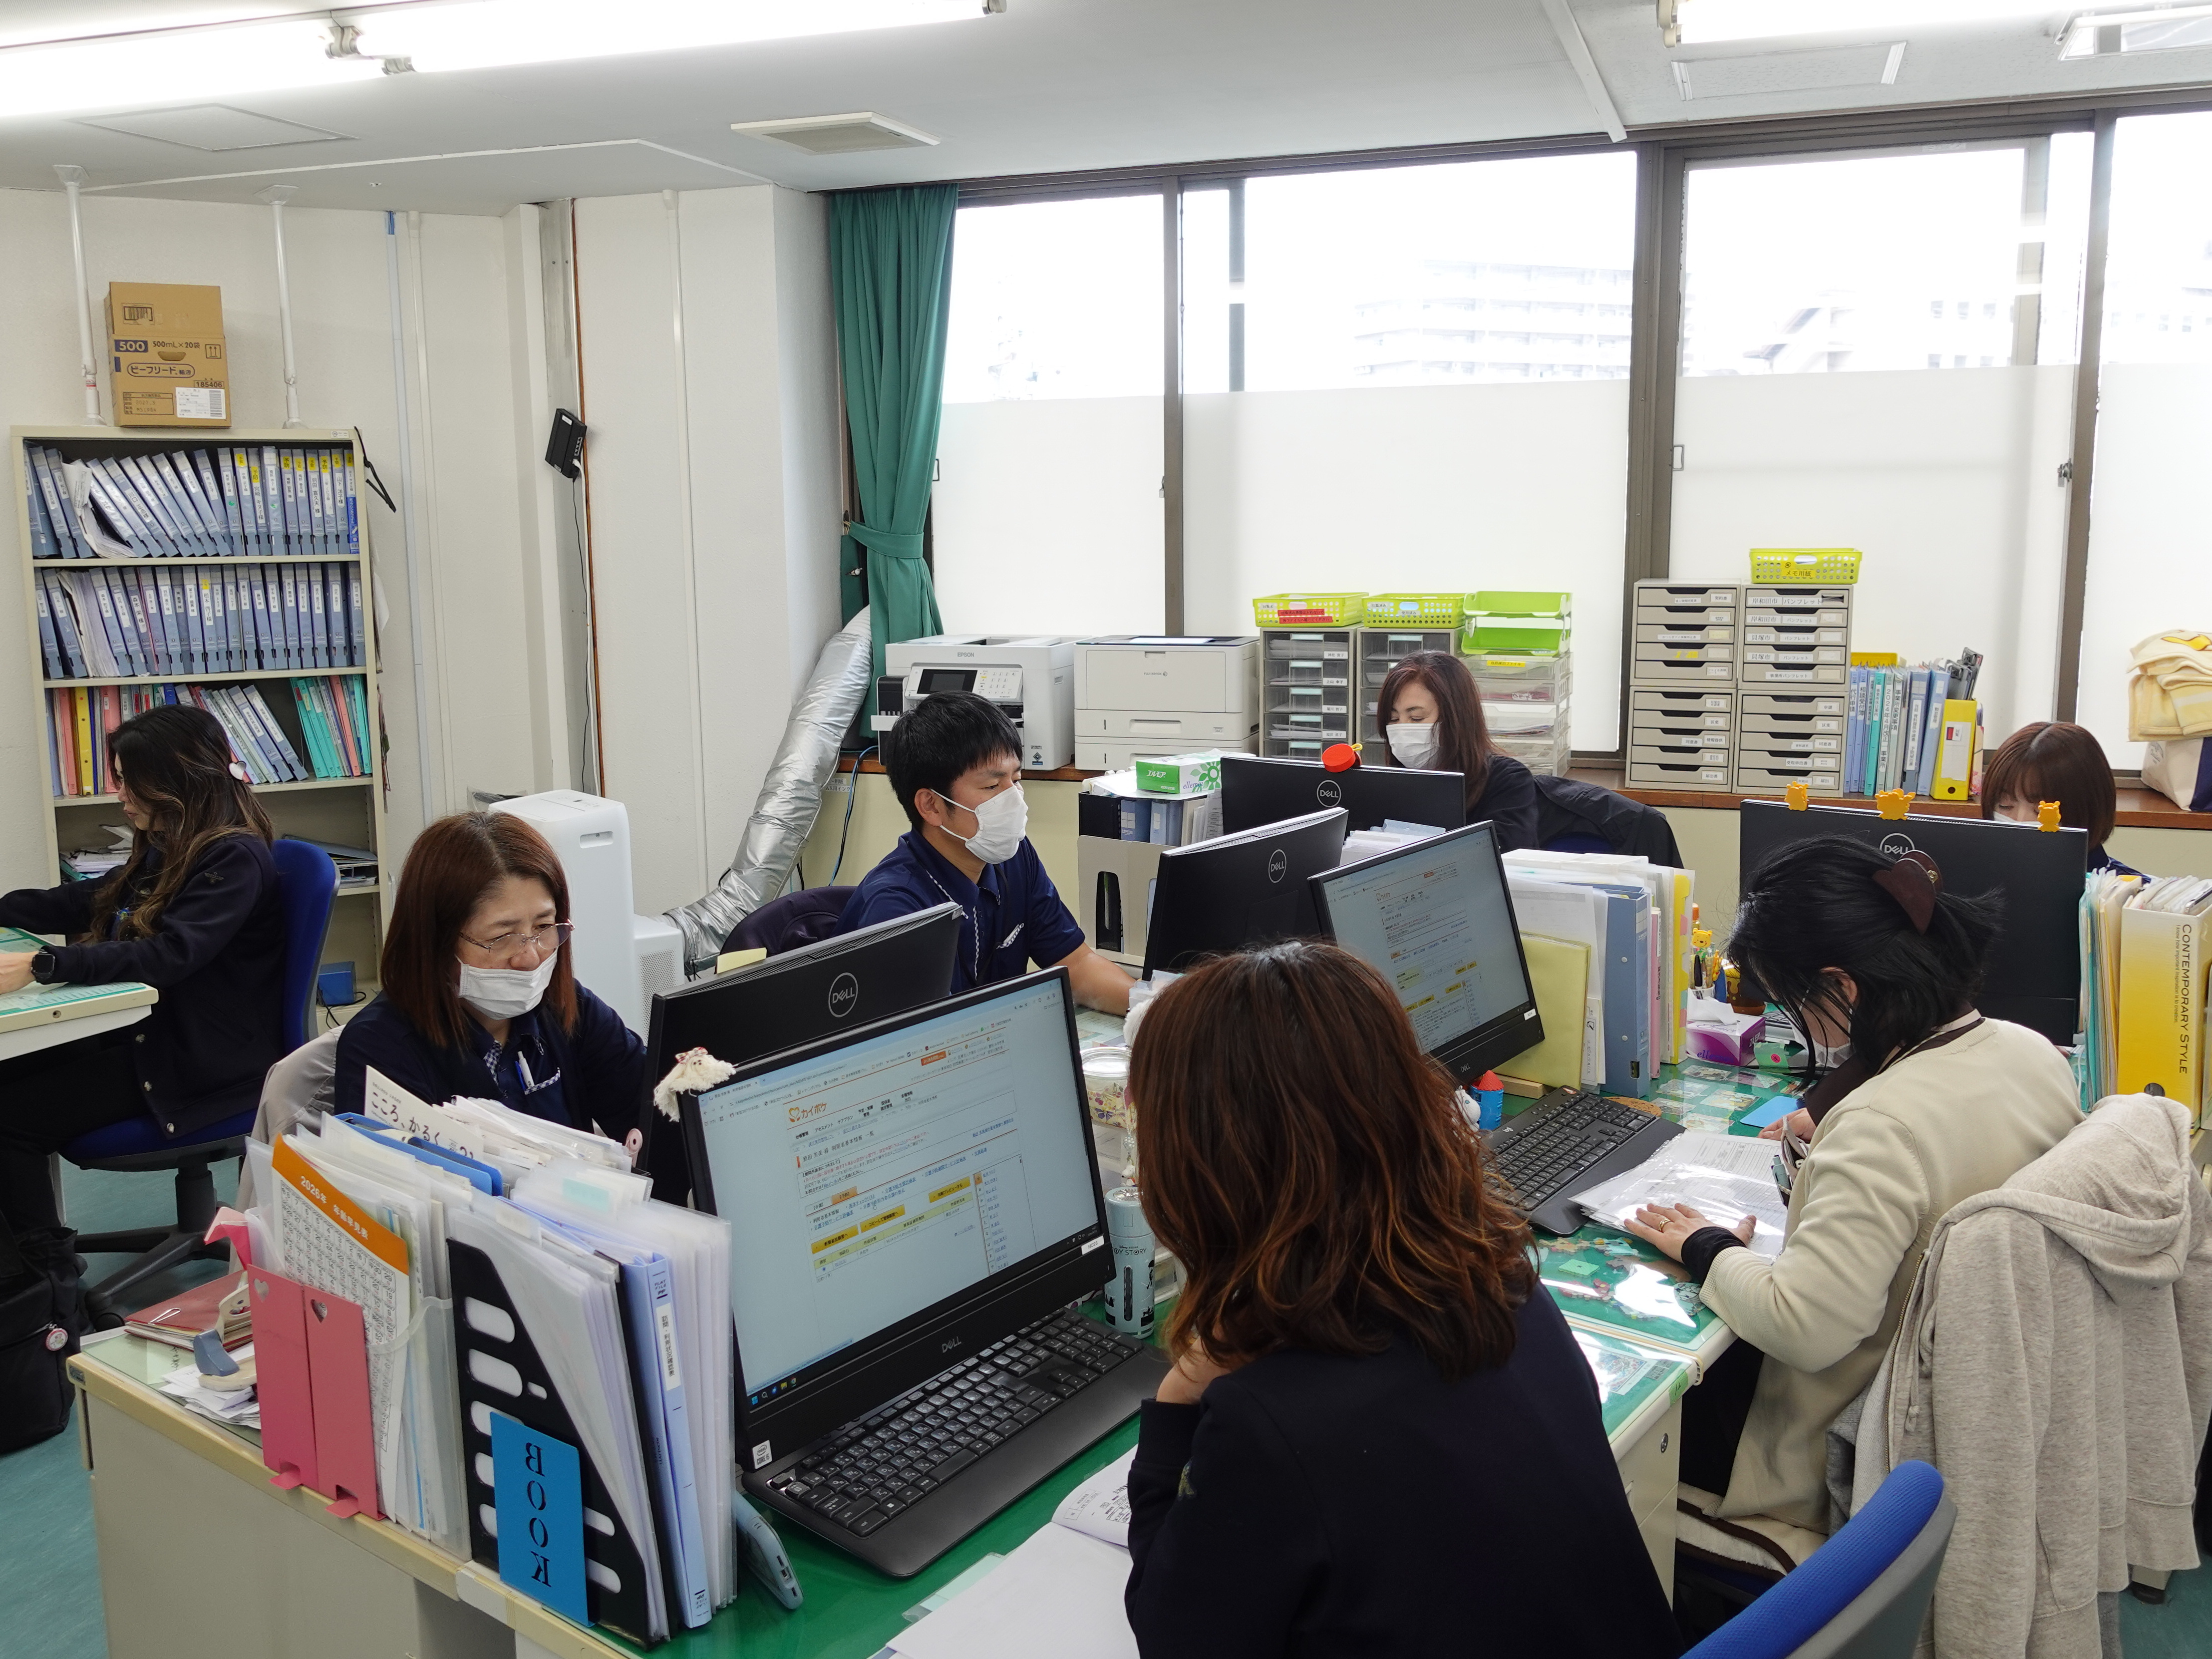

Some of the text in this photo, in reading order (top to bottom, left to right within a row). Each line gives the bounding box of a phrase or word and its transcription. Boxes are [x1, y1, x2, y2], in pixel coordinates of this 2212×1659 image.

[119, 342, 145, 351] 500
[131, 366, 176, 375] ビーフリード
[284, 457, 289, 468] 予防
[322, 459, 328, 470] 予防
[1271, 861, 1285, 872] DELL
[832, 987, 855, 1004] DELL
[1460, 1063, 1470, 1073] DELL
[815, 1123, 833, 1133] アセスメント
[837, 1115, 853, 1124] ケアプラン
[831, 1134, 862, 1151] 利用者基本情報
[333, 1204, 368, 1240] 年齢早見表
[1125, 1247, 1147, 1256] STORY
[941, 1336, 962, 1353] DELL
